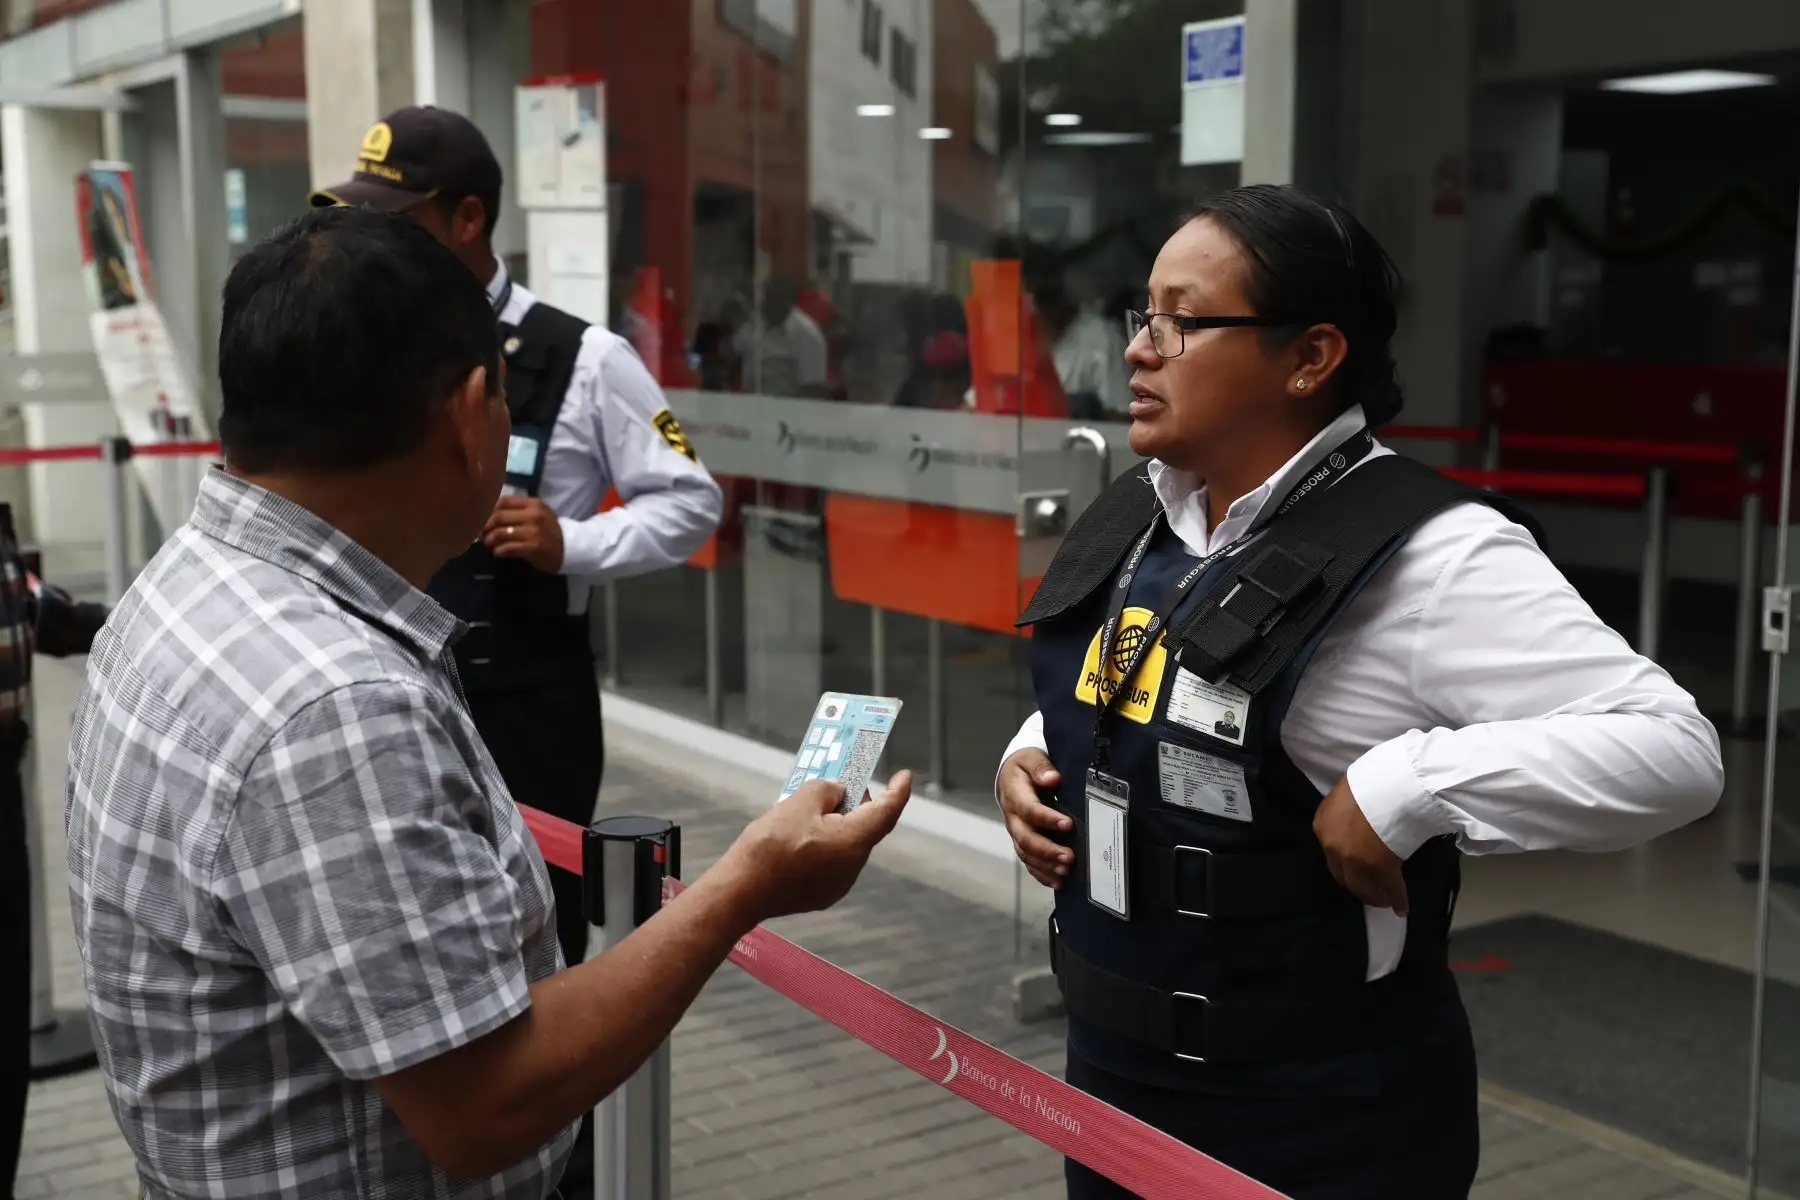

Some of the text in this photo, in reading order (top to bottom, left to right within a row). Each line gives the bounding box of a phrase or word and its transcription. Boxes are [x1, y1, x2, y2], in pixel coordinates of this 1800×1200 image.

[1177, 544, 1233, 589] PROSEGUR
[1085, 671, 1150, 707] PROSUR
[734, 940, 758, 961] ación
[960, 1056, 1081, 1135] Banco de la Nación
